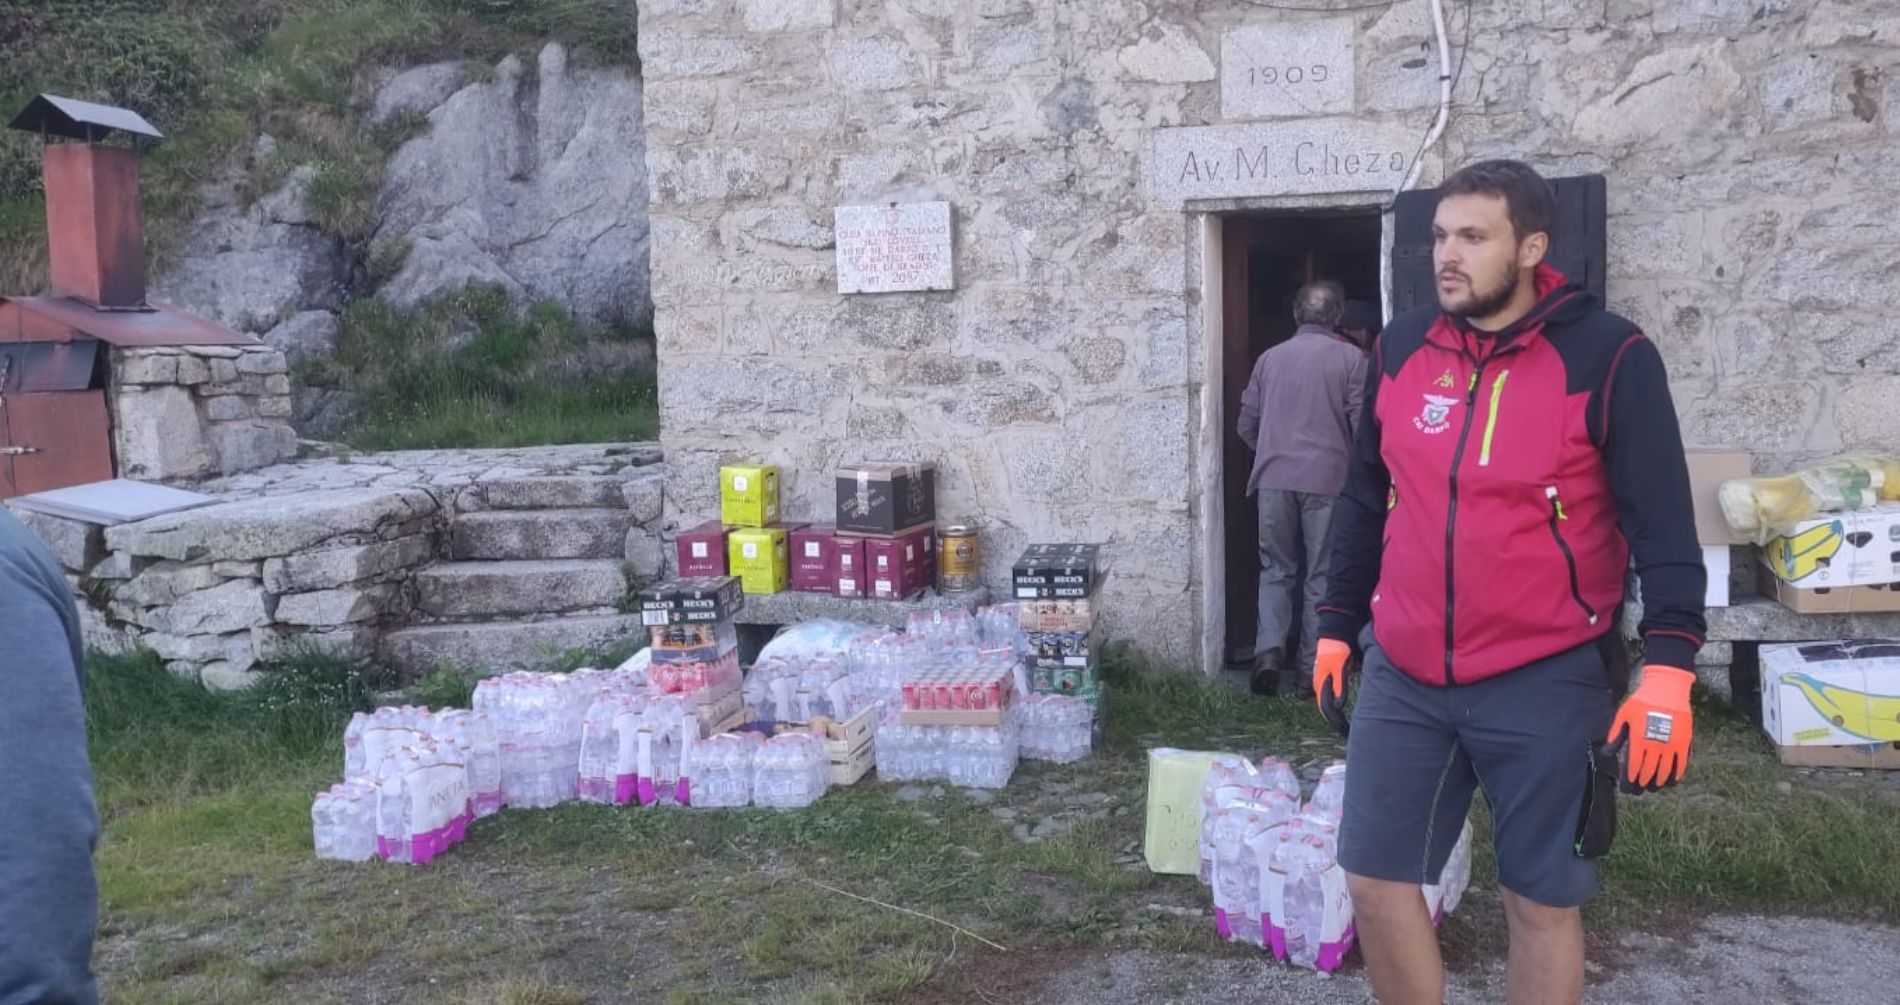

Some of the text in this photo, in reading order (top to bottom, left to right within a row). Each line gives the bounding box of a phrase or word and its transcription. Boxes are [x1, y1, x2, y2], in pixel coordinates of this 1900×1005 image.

[1247, 64, 1329, 87] 1909
[1235, 145, 1279, 180] M.
[1294, 141, 1405, 176] Gheza
[643, 601, 675, 609] BECK'S
[683, 599, 715, 608] BECK'S
[687, 611, 717, 620] BECK'S
